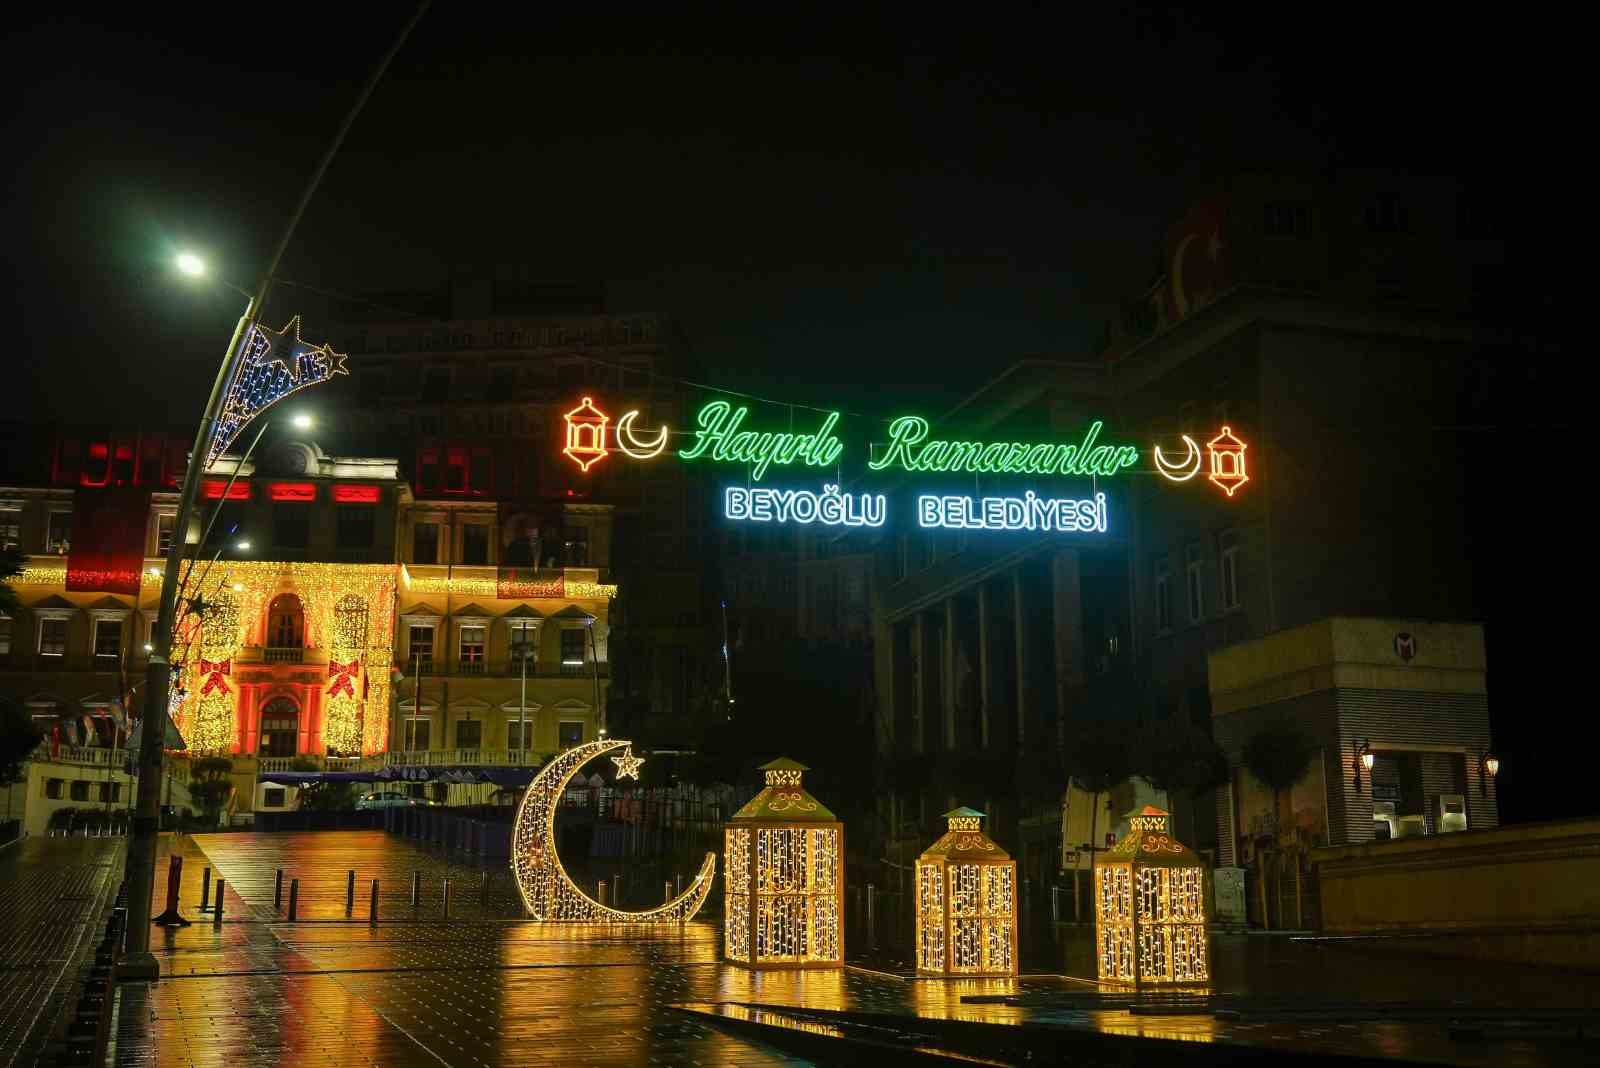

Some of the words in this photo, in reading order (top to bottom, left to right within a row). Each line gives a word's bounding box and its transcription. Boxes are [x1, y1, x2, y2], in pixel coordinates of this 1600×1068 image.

[679, 401, 843, 481] Hayırlı
[868, 416, 1139, 475] Ramazanlar
[725, 484, 886, 528] BEYOĞLU
[918, 490, 1107, 532] BELEDİYESİ
